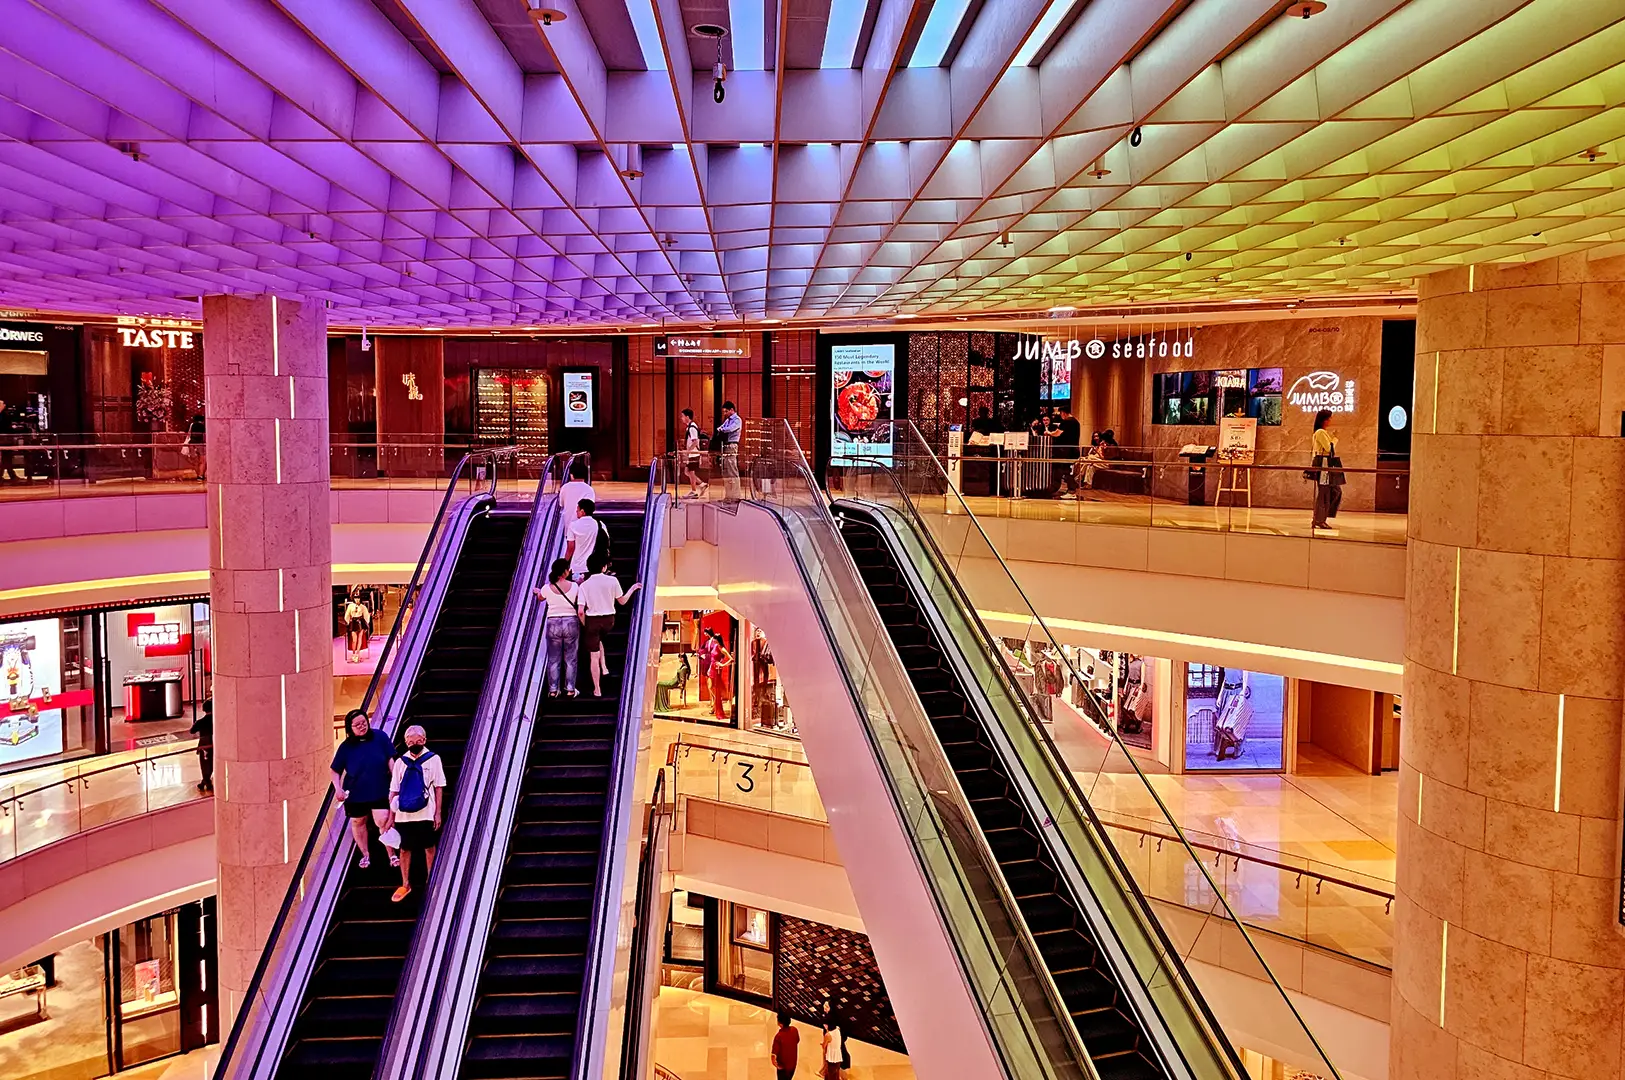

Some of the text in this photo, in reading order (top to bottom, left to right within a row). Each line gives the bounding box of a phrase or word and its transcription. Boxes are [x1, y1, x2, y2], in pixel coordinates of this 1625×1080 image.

[117, 327, 194, 349] TASTE
[1012, 337, 1193, 360] JUMBO seafood
[1289, 391, 1344, 405] JUMBO
[138, 631, 180, 646] DARE
[736, 762, 754, 793] 3
